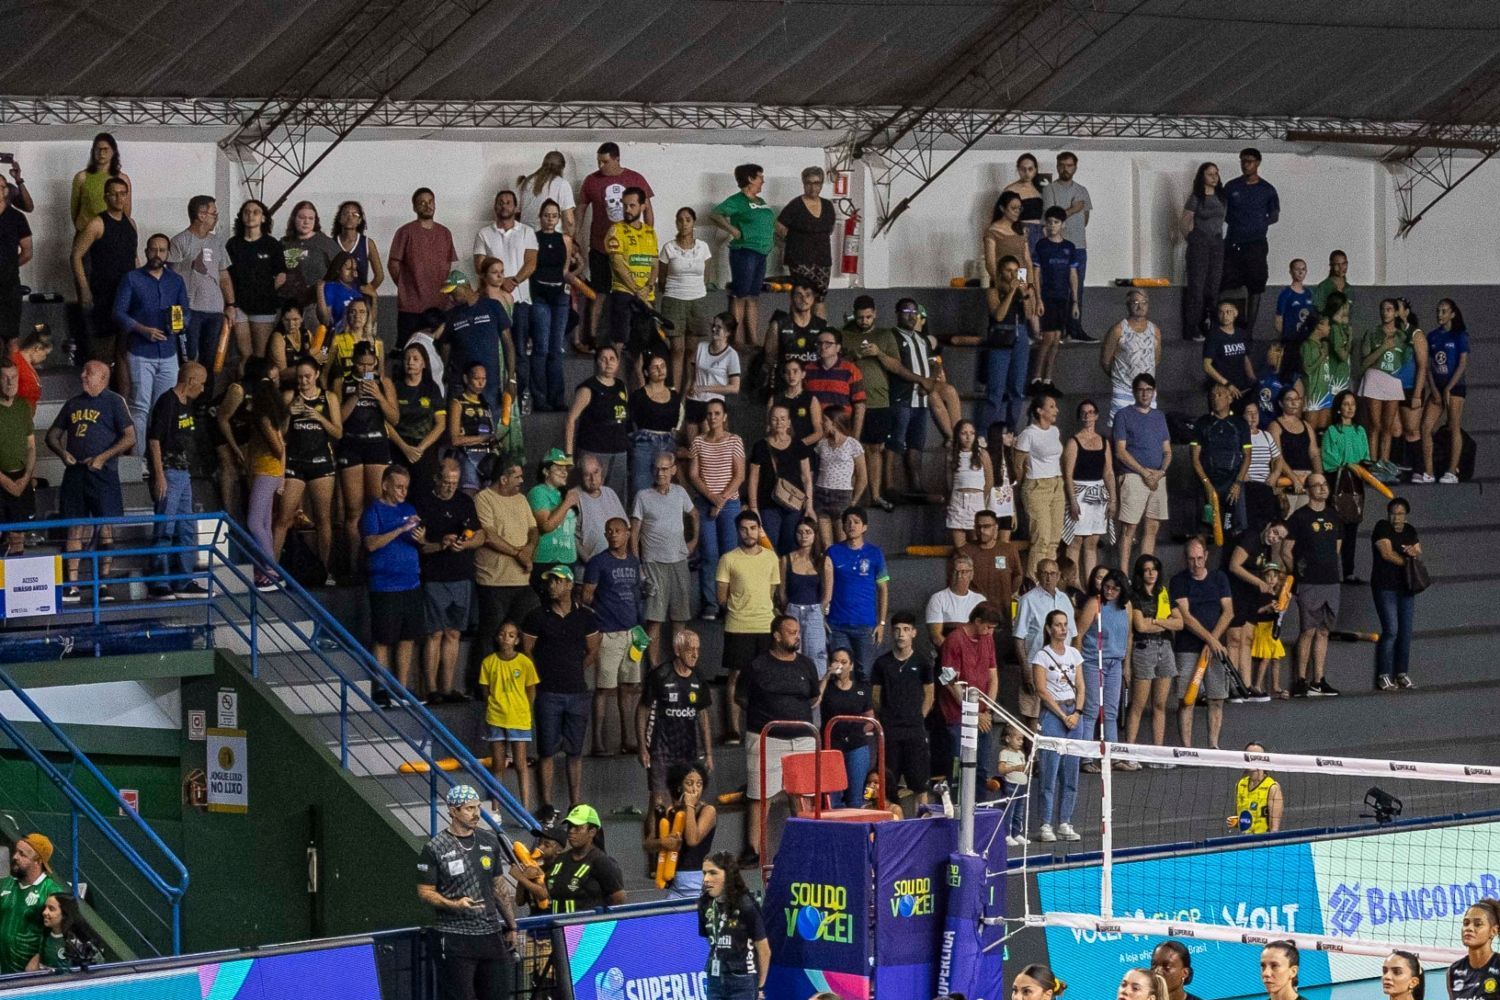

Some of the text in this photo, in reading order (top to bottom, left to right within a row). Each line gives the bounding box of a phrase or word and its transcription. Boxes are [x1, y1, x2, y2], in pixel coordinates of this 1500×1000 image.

[210, 782, 243, 794] NO LIXO
[790, 882, 847, 911] SOU DO
[893, 877, 931, 897] SOU DO
[1366, 884, 1446, 926] BANCO
[1450, 882, 1480, 915] DO
